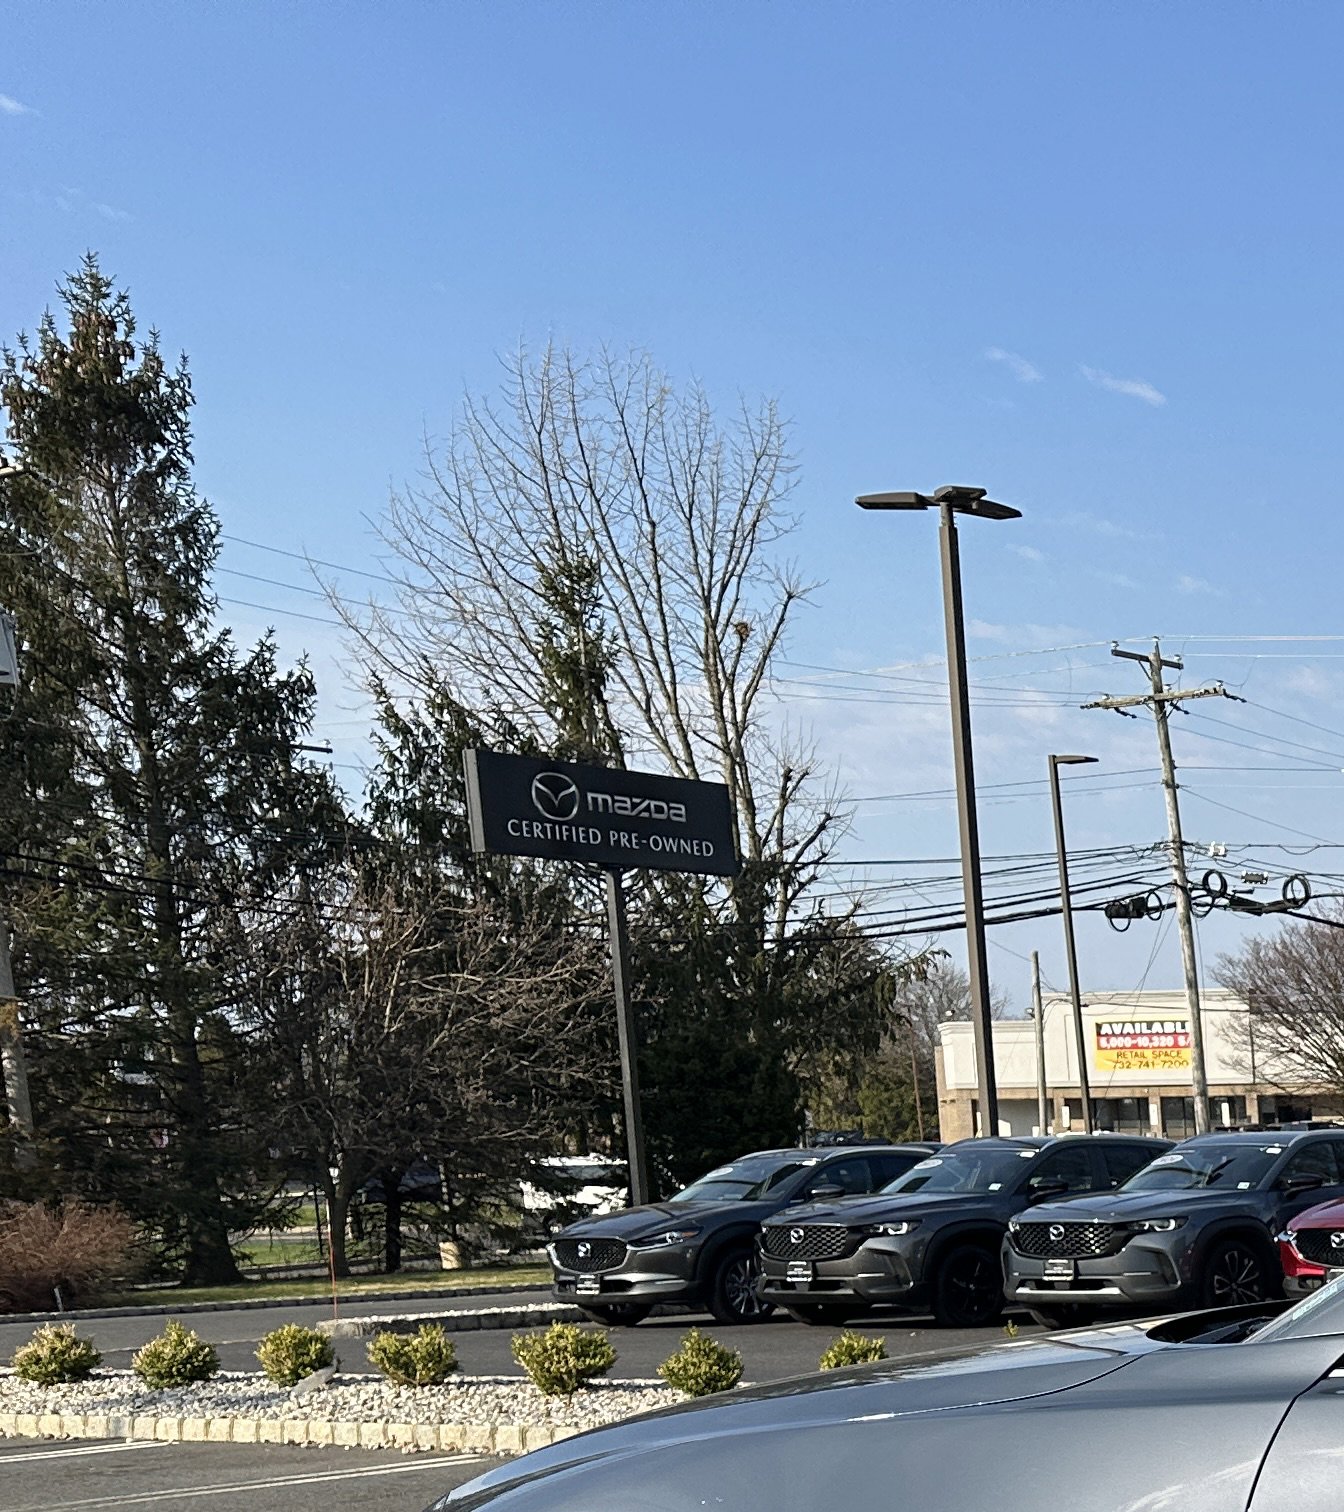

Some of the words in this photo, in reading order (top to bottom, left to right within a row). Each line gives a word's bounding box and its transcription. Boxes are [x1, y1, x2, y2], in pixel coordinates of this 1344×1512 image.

[507, 818, 601, 845] CERTIFIED
[609, 830, 714, 857] PRE-OWNED
[1116, 1051, 1147, 1059] RETAIL
[1151, 1050, 1183, 1059] SPACE
[1112, 1060, 1189, 1070] 732-741-7200
